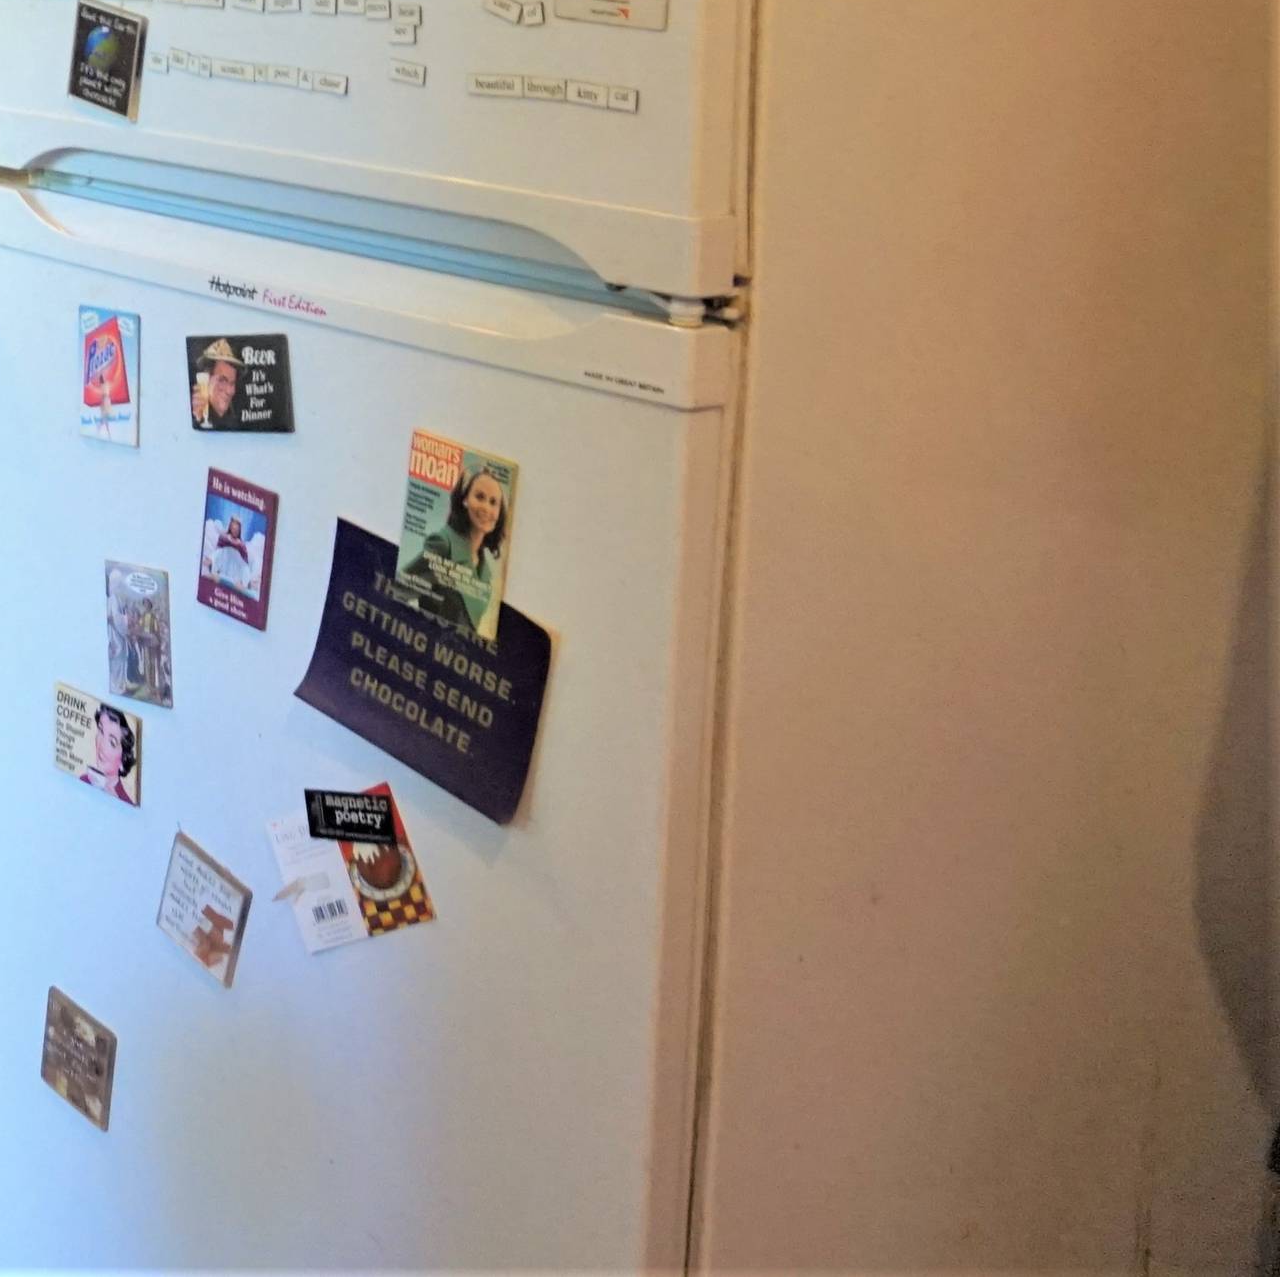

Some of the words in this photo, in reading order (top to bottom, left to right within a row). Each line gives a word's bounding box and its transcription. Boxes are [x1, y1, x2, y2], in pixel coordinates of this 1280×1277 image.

[475, 78, 515, 91] beautiful
[208, 274, 258, 301] Hotpoint
[245, 382, 274, 396] What's
[241, 408, 273, 422] Dinner
[249, 396, 266, 409] For
[411, 432, 461, 465] woman's
[409, 449, 459, 489] moan
[342, 591, 429, 653] GETTING
[351, 630, 429, 690] PLEASE
[432, 679, 494, 728] SEND
[56, 688, 87, 713] DRINK
[56, 705, 92, 731] COFFEE
[324, 793, 388, 812] magnetic
[334, 809, 382, 830] poetry
